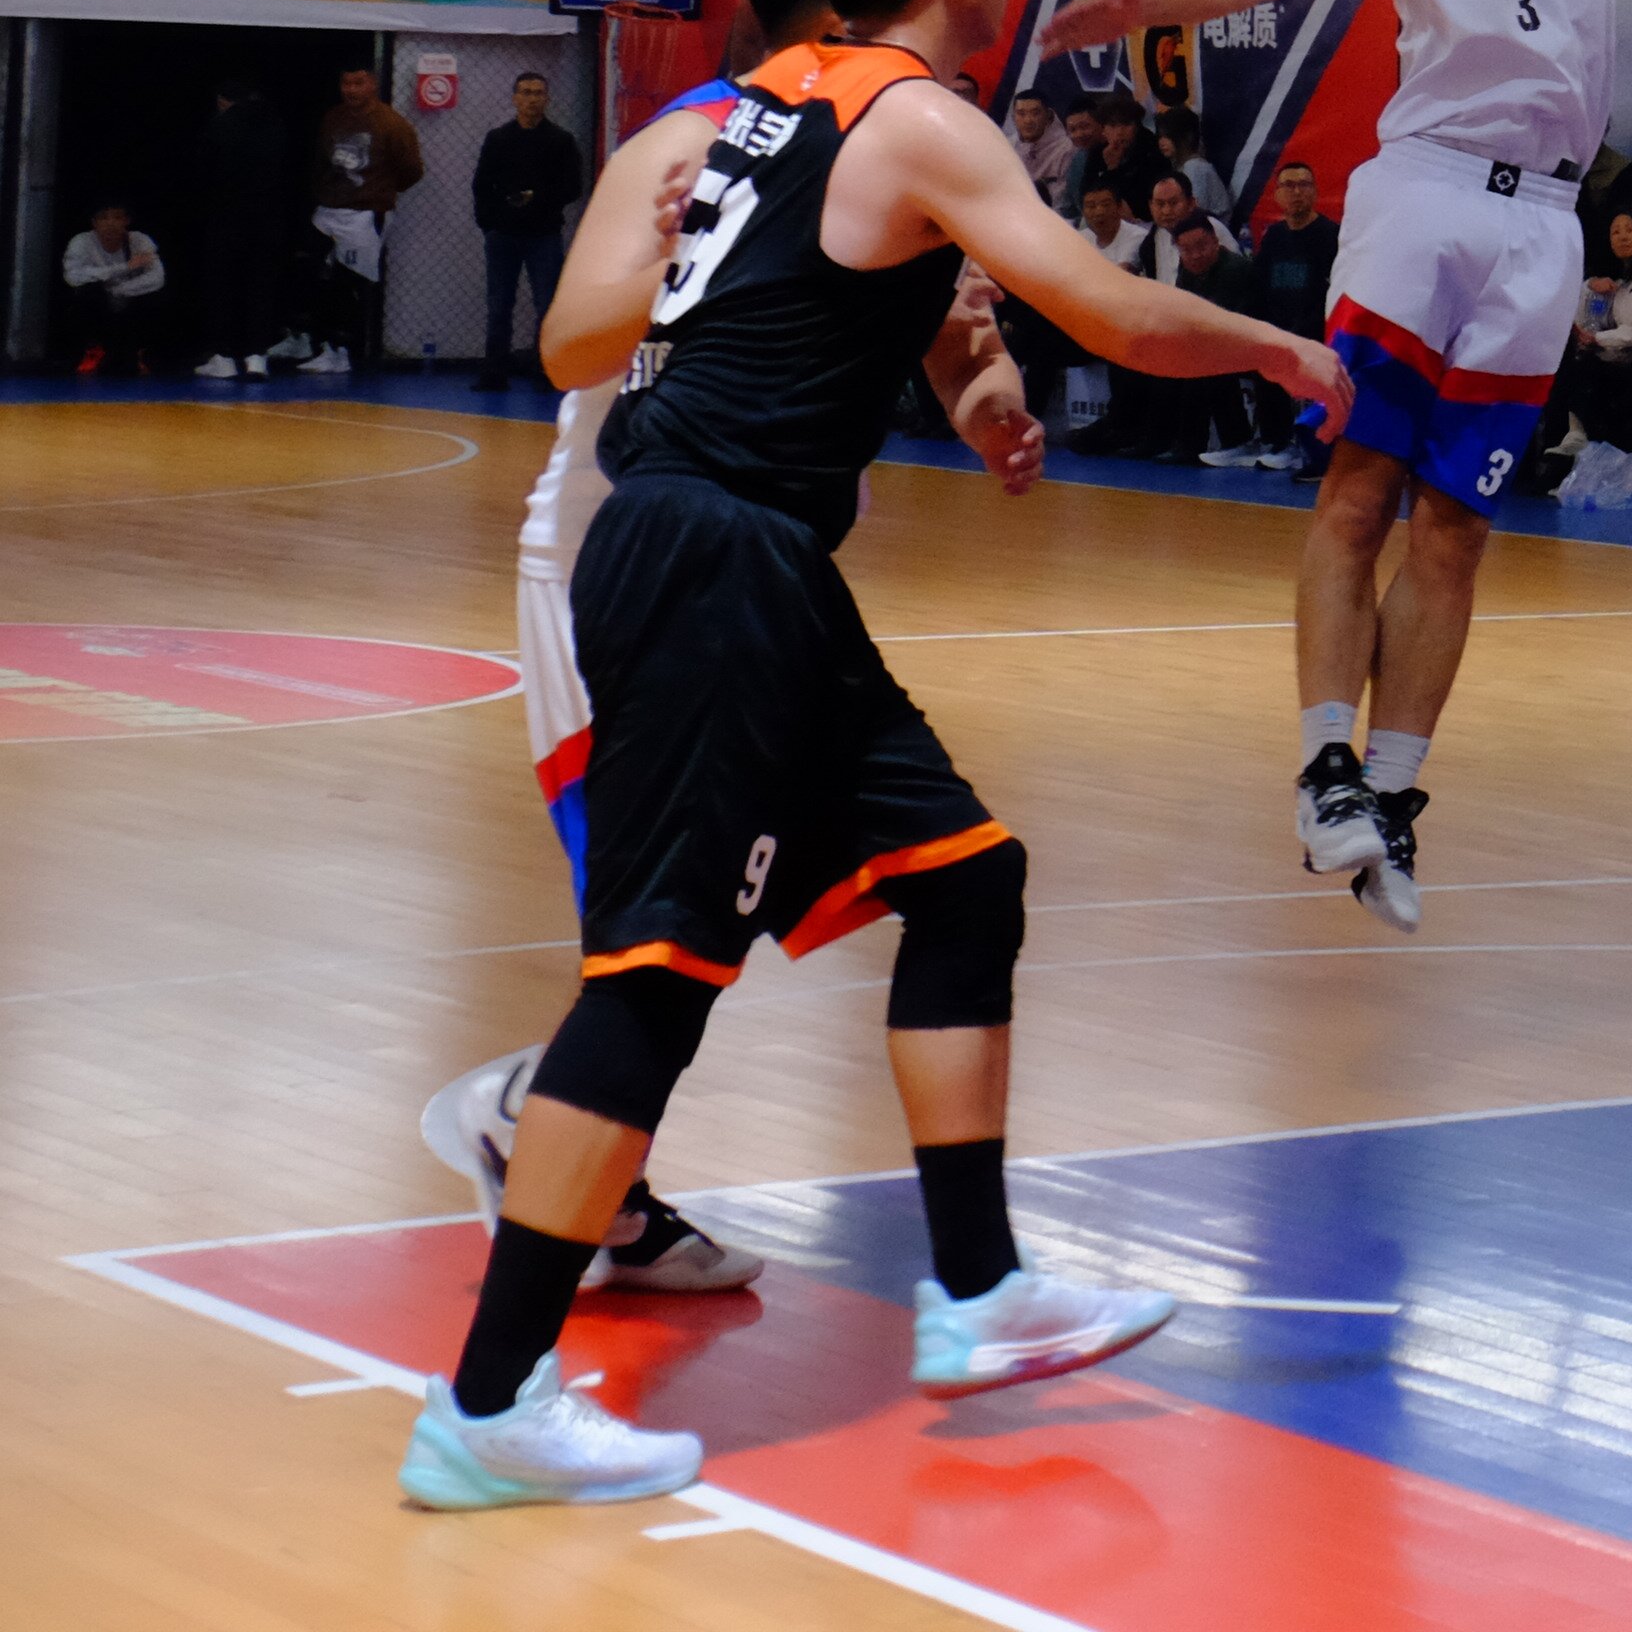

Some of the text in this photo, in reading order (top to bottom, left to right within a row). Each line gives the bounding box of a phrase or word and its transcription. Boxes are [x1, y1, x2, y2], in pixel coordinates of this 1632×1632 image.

[1144, 25, 1189, 108] G
[1475, 448, 1514, 497] 3
[735, 834, 778, 917] 9
